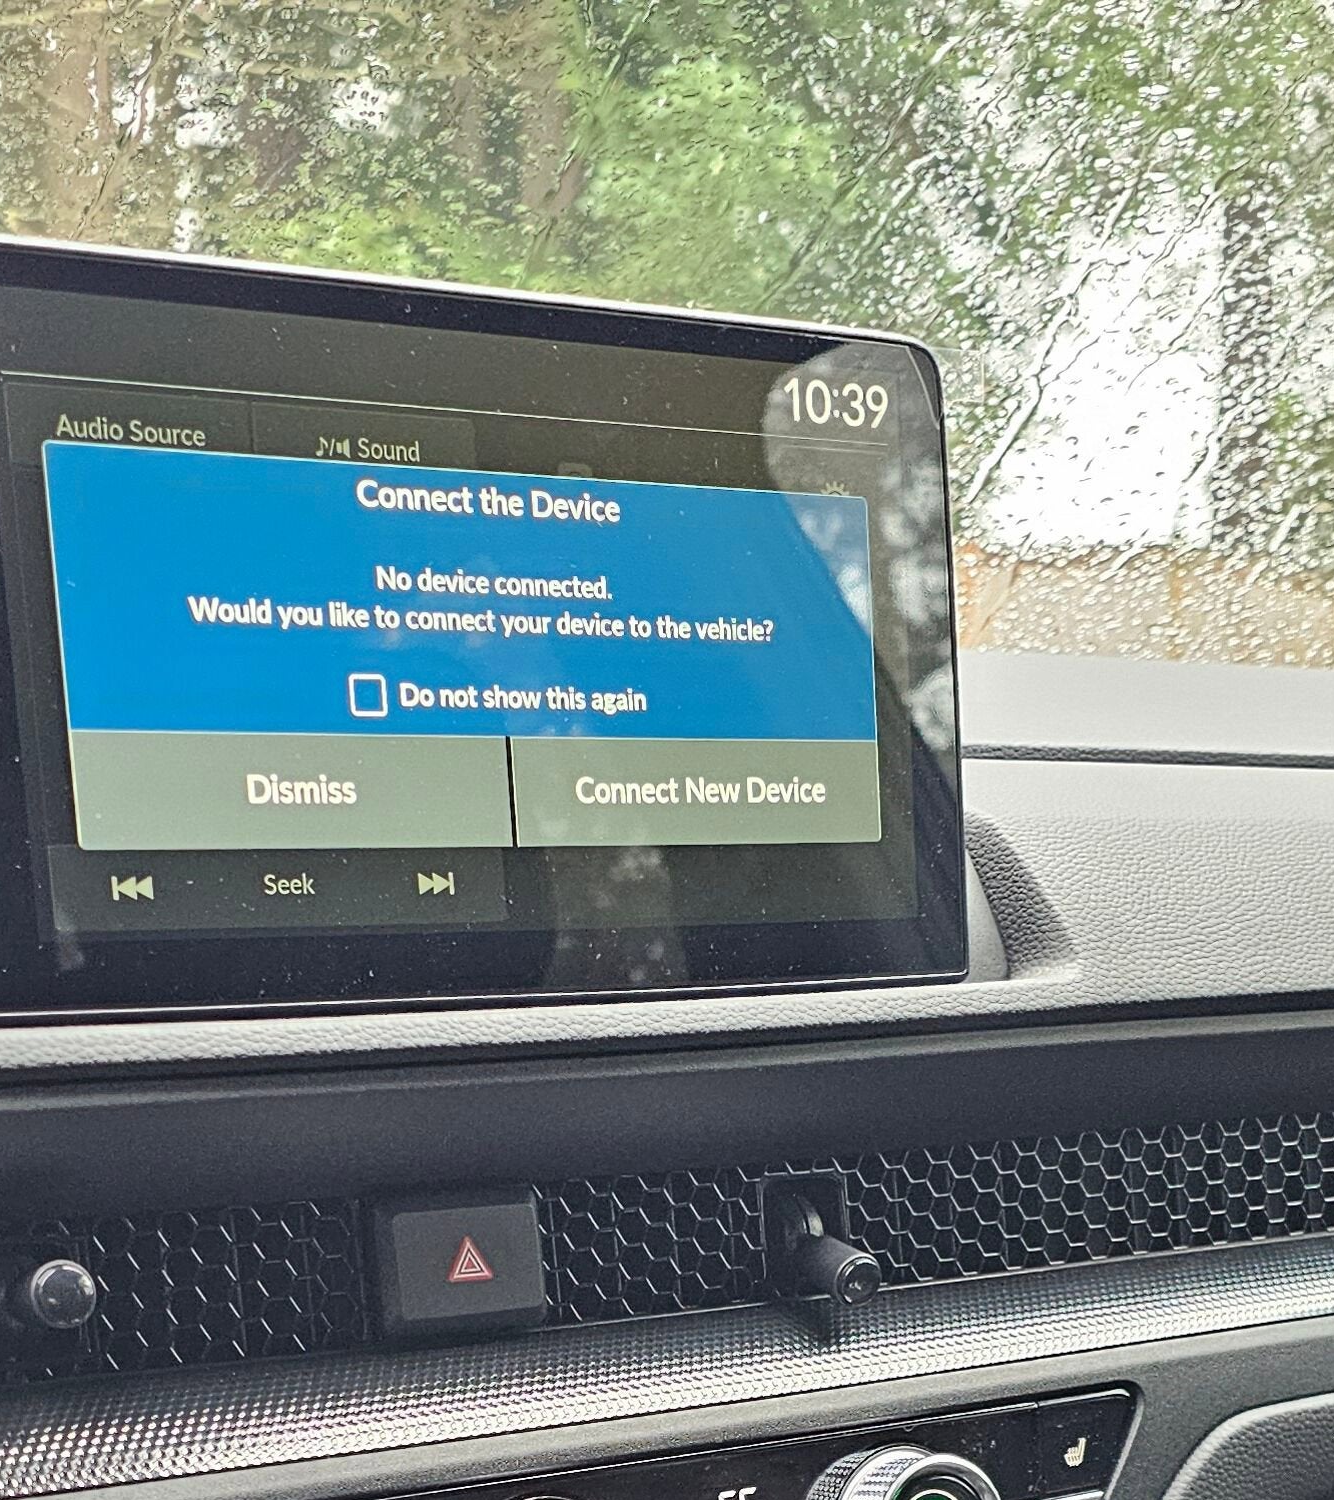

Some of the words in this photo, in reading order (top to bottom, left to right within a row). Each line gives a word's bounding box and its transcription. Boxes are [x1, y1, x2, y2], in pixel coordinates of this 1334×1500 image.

[784, 377, 888, 429] 10:39
[56, 413, 124, 441] Audio
[130, 420, 206, 447] Source
[356, 438, 420, 463] Sound
[356, 479, 474, 515] Connect
[479, 486, 524, 517] the
[531, 490, 620, 523] Device
[376, 565, 412, 592] No
[417, 567, 489, 596] device
[494, 575, 613, 601] connected.
[187, 595, 272, 625] Would
[277, 604, 323, 630] you
[328, 600, 370, 628] like
[373, 605, 400, 630] to
[405, 609, 496, 633] connect
[500, 613, 552, 638] your
[556, 611, 625, 637] device
[629, 615, 652, 638] to
[656, 615, 691, 639] the
[695, 616, 774, 642] vehicle?
[399, 682, 435, 708] Do
[439, 684, 478, 709] not
[482, 684, 542, 710] show
[546, 686, 586, 711] this
[591, 688, 647, 715] again
[246, 773, 357, 805] Dismiss
[575, 776, 680, 805] Connect
[685, 776, 741, 804] New
[746, 776, 826, 805] Device
[263, 872, 316, 896] Seek
